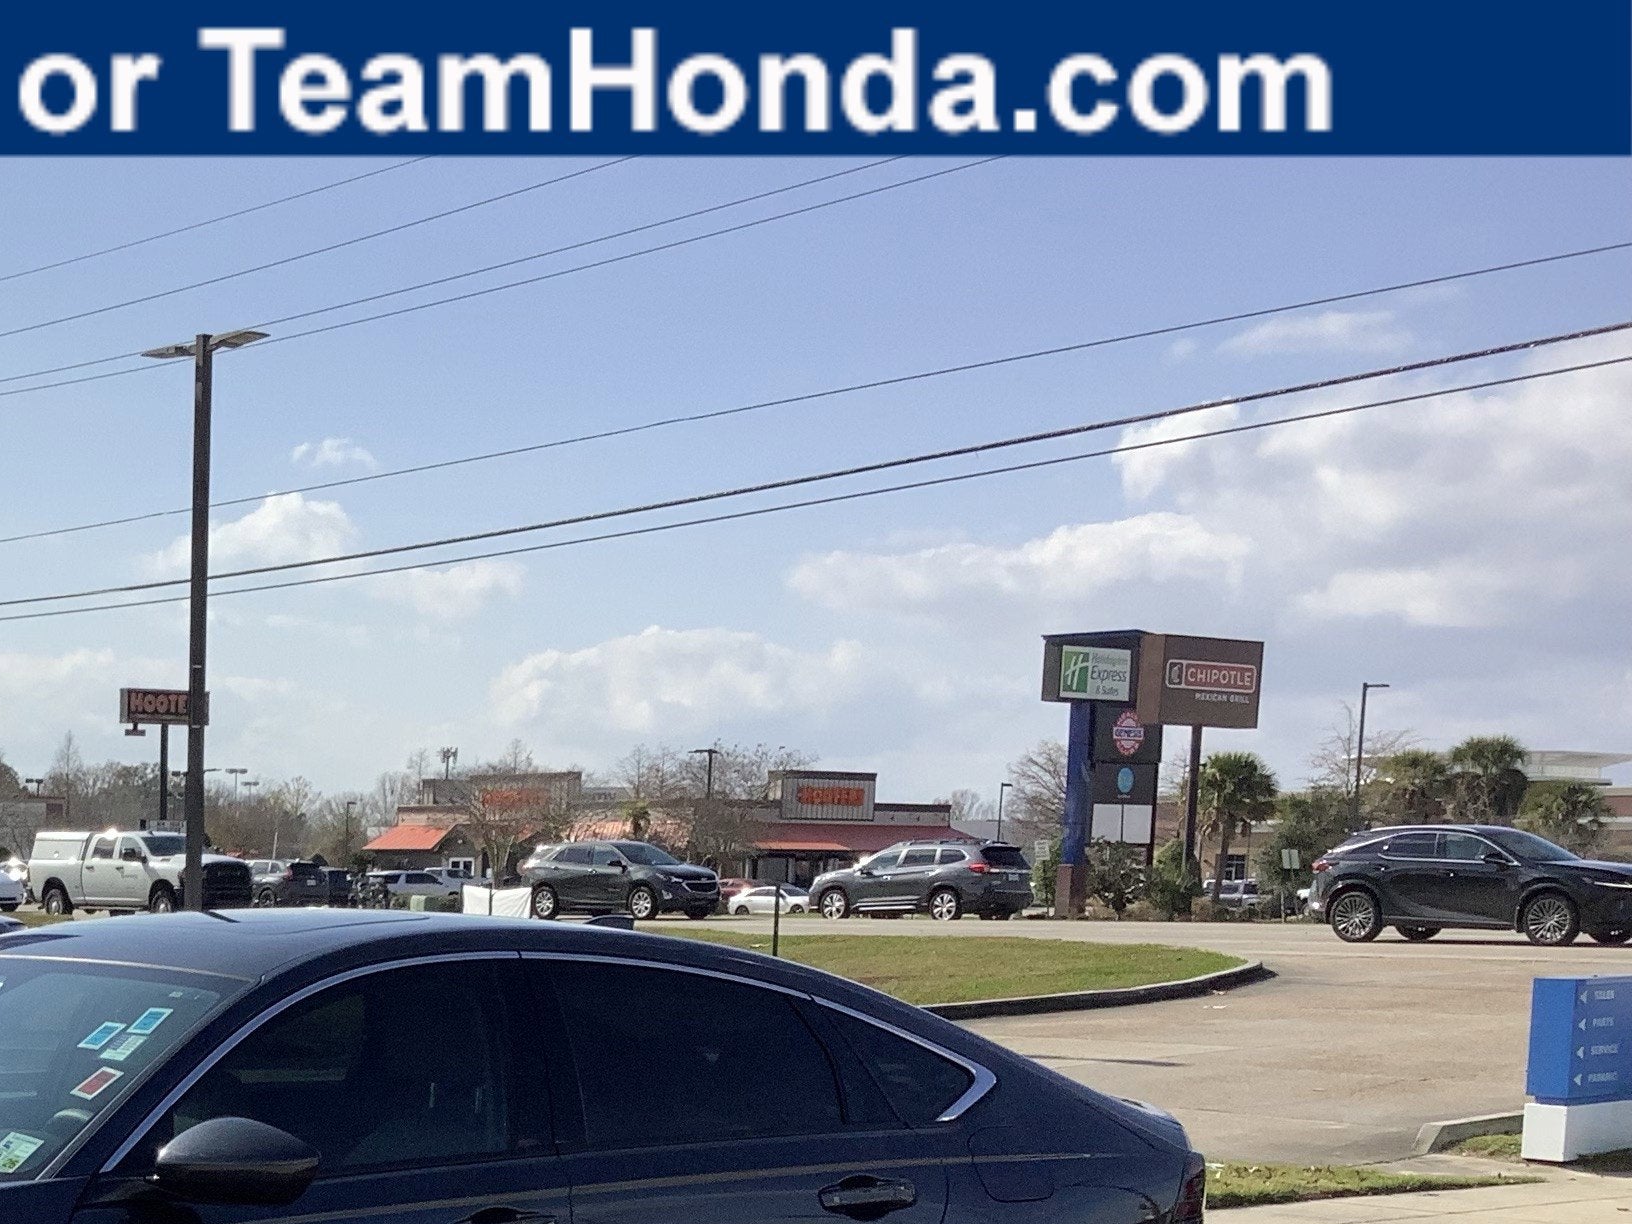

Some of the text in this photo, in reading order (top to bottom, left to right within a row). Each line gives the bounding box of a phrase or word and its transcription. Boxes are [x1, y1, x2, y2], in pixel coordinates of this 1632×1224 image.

[1091, 665, 1127, 683] Express
[1187, 668, 1252, 686] CHIPOTLE
[129, 692, 189, 713] HOOTE
